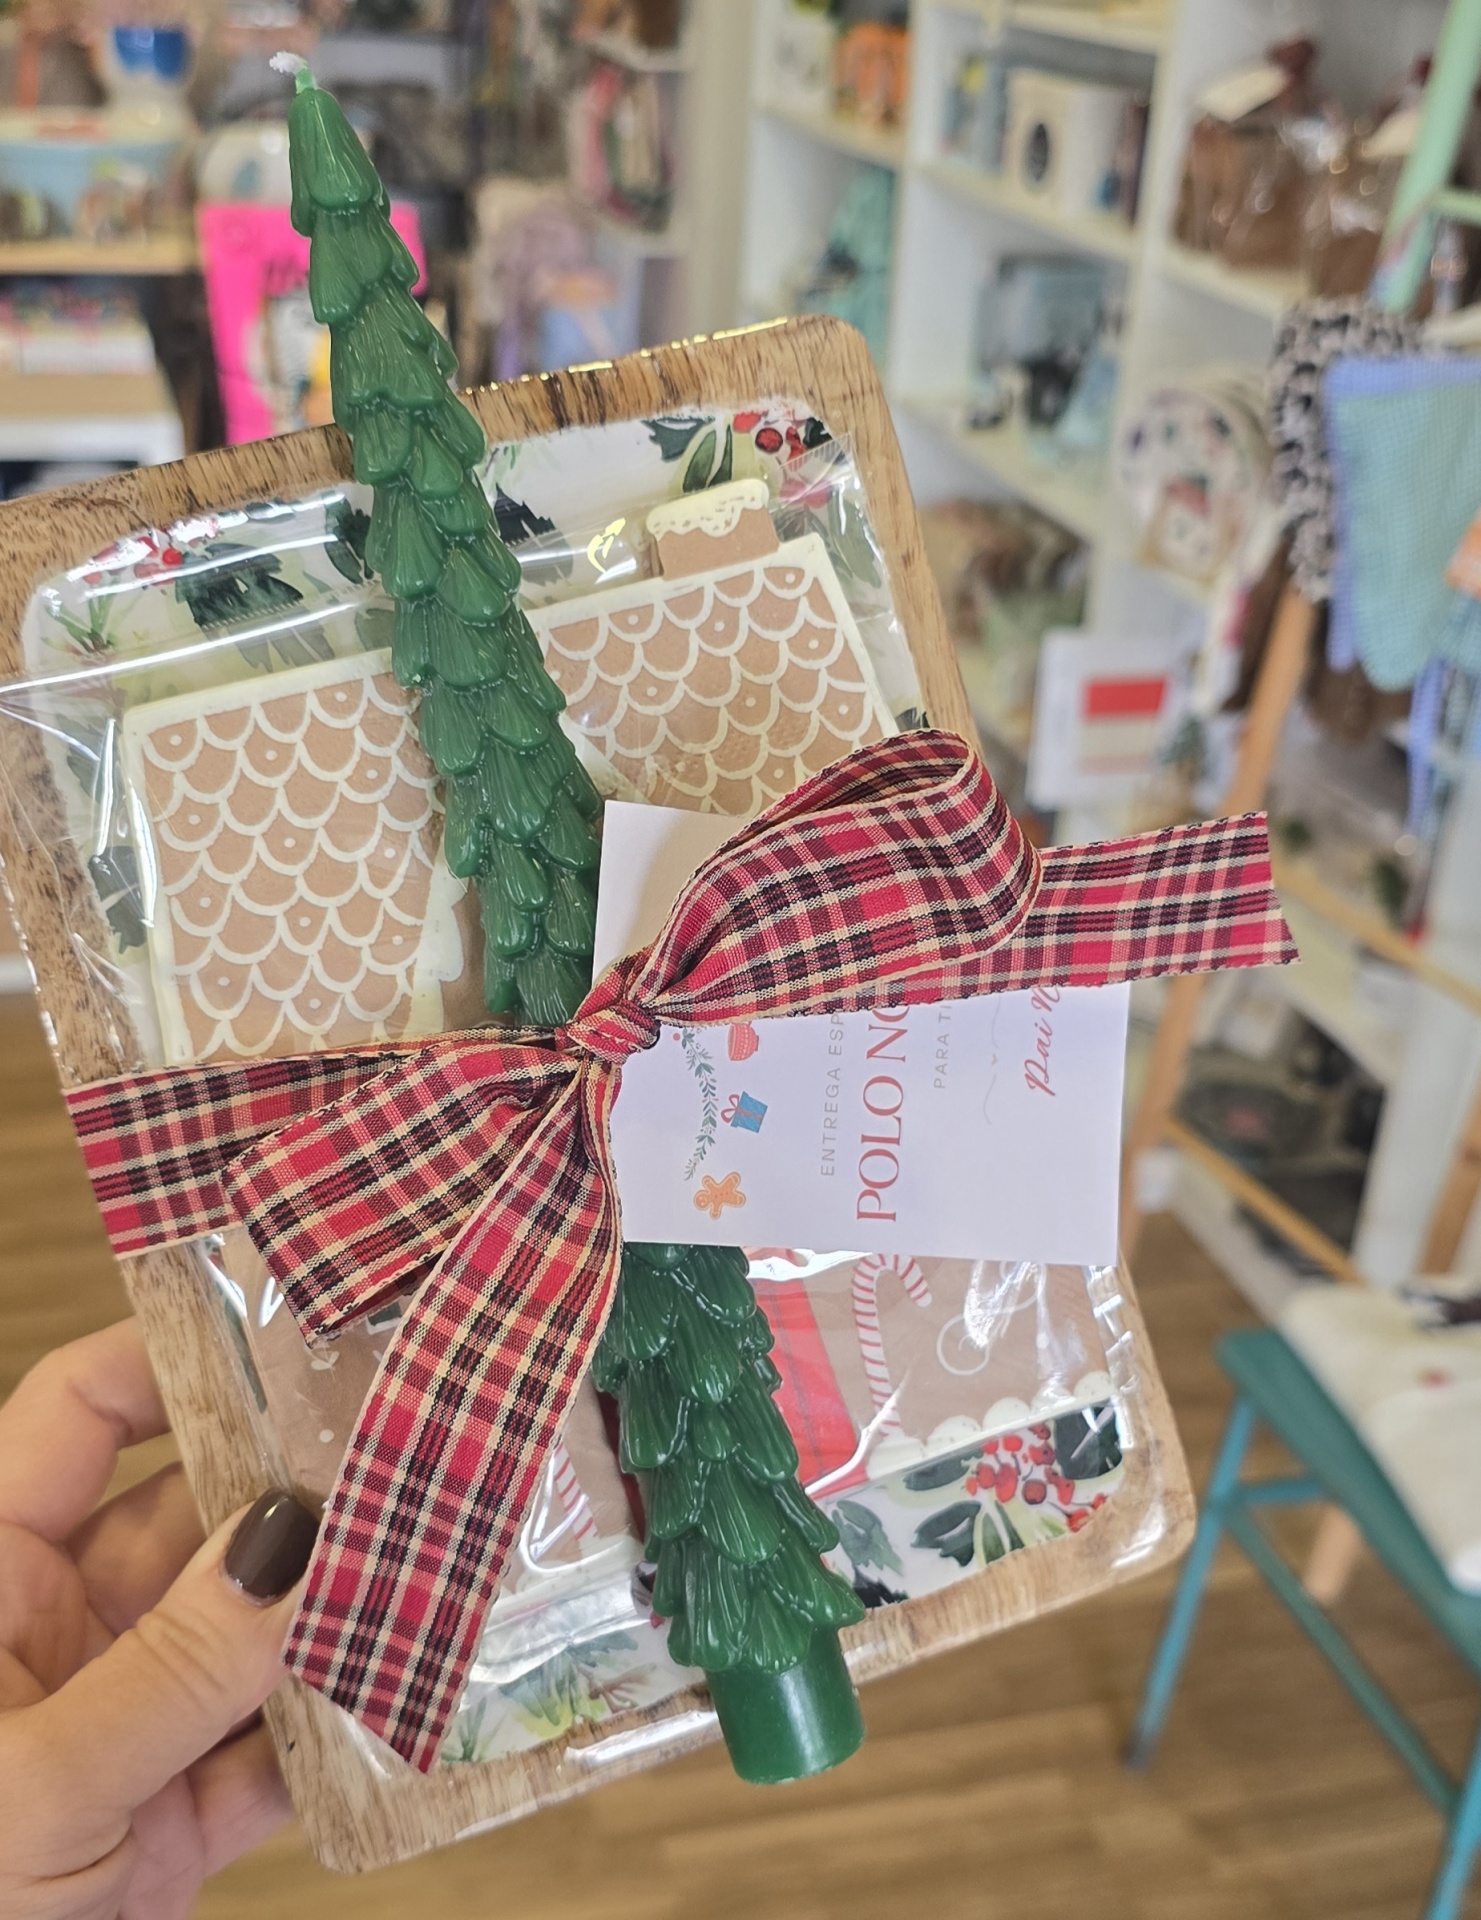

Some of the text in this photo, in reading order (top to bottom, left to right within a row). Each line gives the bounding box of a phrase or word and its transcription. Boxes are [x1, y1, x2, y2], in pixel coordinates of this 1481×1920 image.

[933, 1033, 950, 1089] PARA
[1023, 1017, 1056, 1097] Pai
[821, 1067, 841, 1177] ENTREGA
[856, 1075, 904, 1222] POLO
